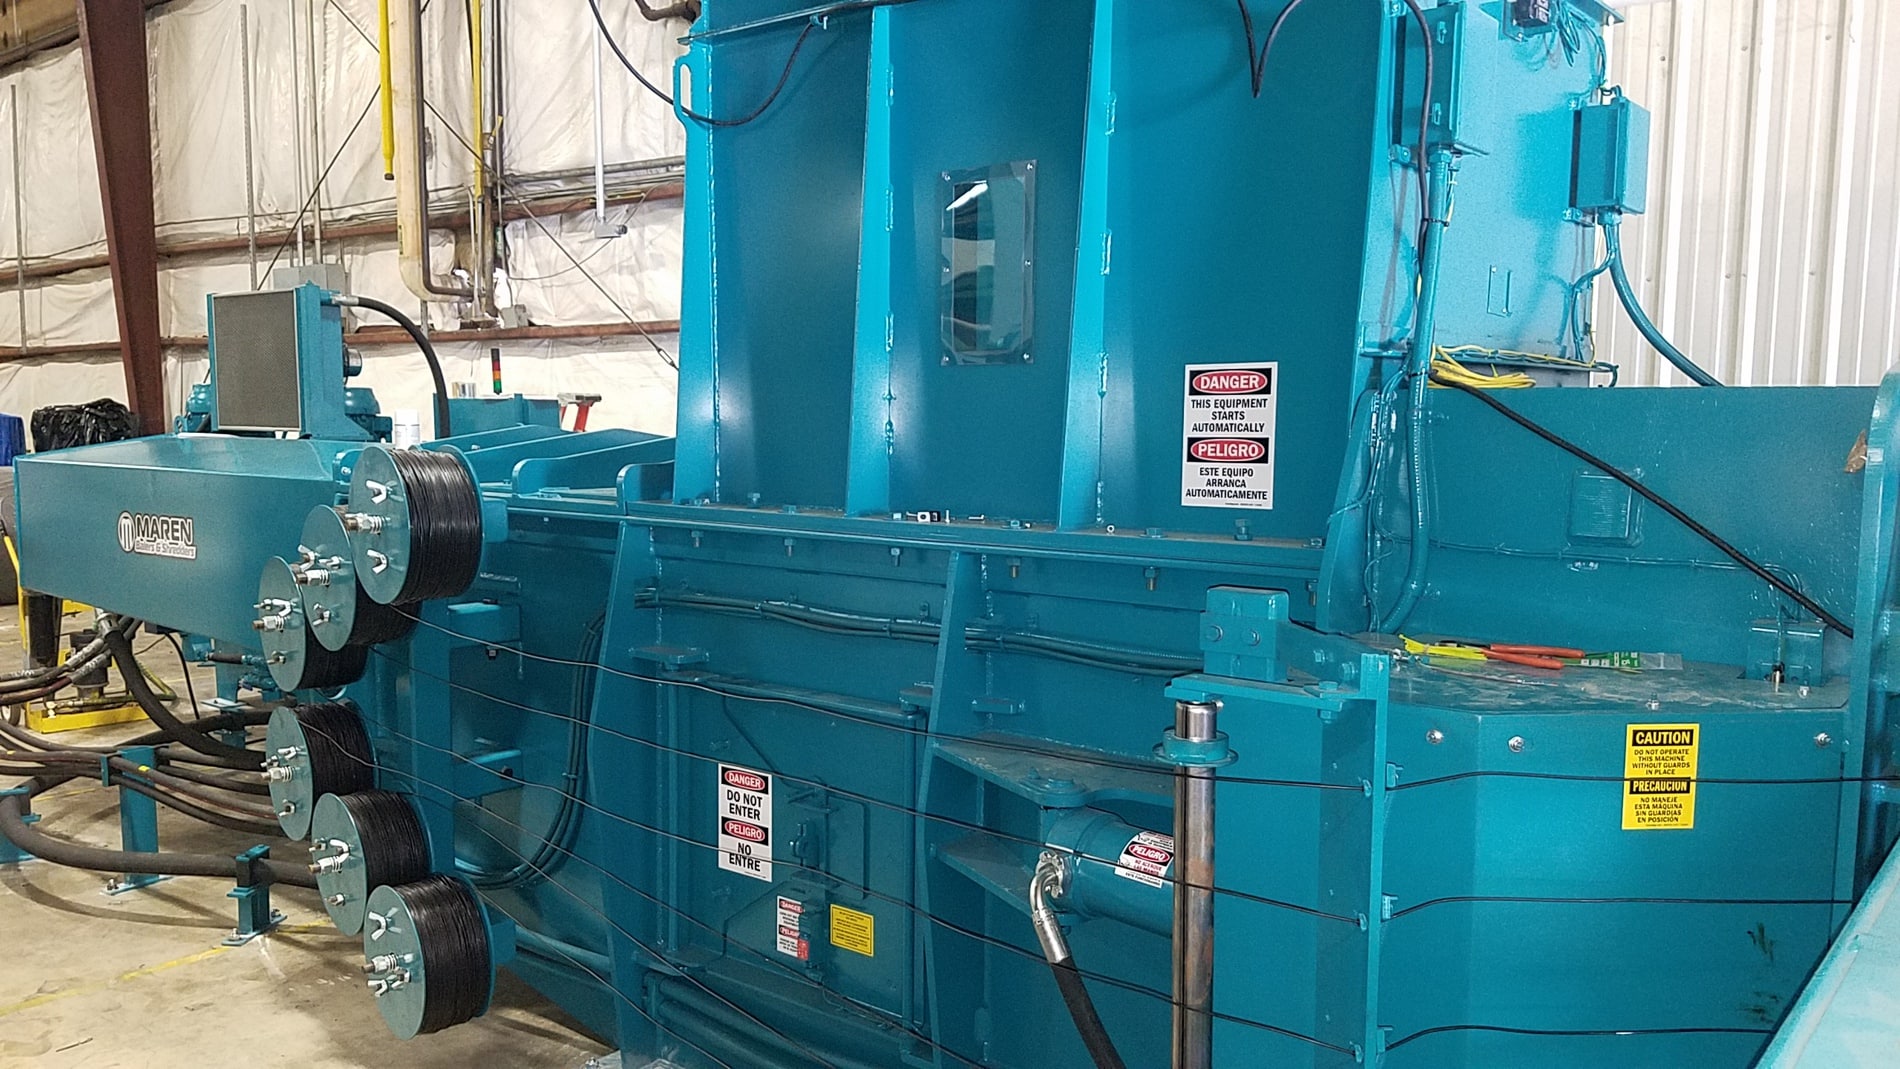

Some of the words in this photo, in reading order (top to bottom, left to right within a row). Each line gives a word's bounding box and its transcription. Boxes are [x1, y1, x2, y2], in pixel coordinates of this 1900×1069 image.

[1200, 375, 1259, 389] DANGER
[1191, 399, 1211, 408] THIS
[1214, 398, 1268, 409] EQUIPMENT
[1211, 411, 1245, 420] STARTS
[1191, 423, 1265, 432] AUTOMATICALLY
[1198, 444, 1259, 457] PELIGRO
[1199, 467, 1219, 476] ESTE
[1222, 468, 1254, 478] EQUIPO
[1206, 479, 1246, 488] ARRANCA
[1186, 489, 1268, 500] AUTOMATICAMENTE
[136, 515, 193, 543] MAREN
[1636, 731, 1691, 744] CAUTION
[728, 772, 761, 788] DANGER
[727, 789, 740, 802] DO
[743, 793, 762, 808] NOT
[729, 803, 760, 821] ENTER
[728, 822, 762, 839] PELIGRO
[738, 842, 751, 856] NO
[1133, 846, 1166, 860] PELIGRO
[729, 853, 760, 872] ENTRE
